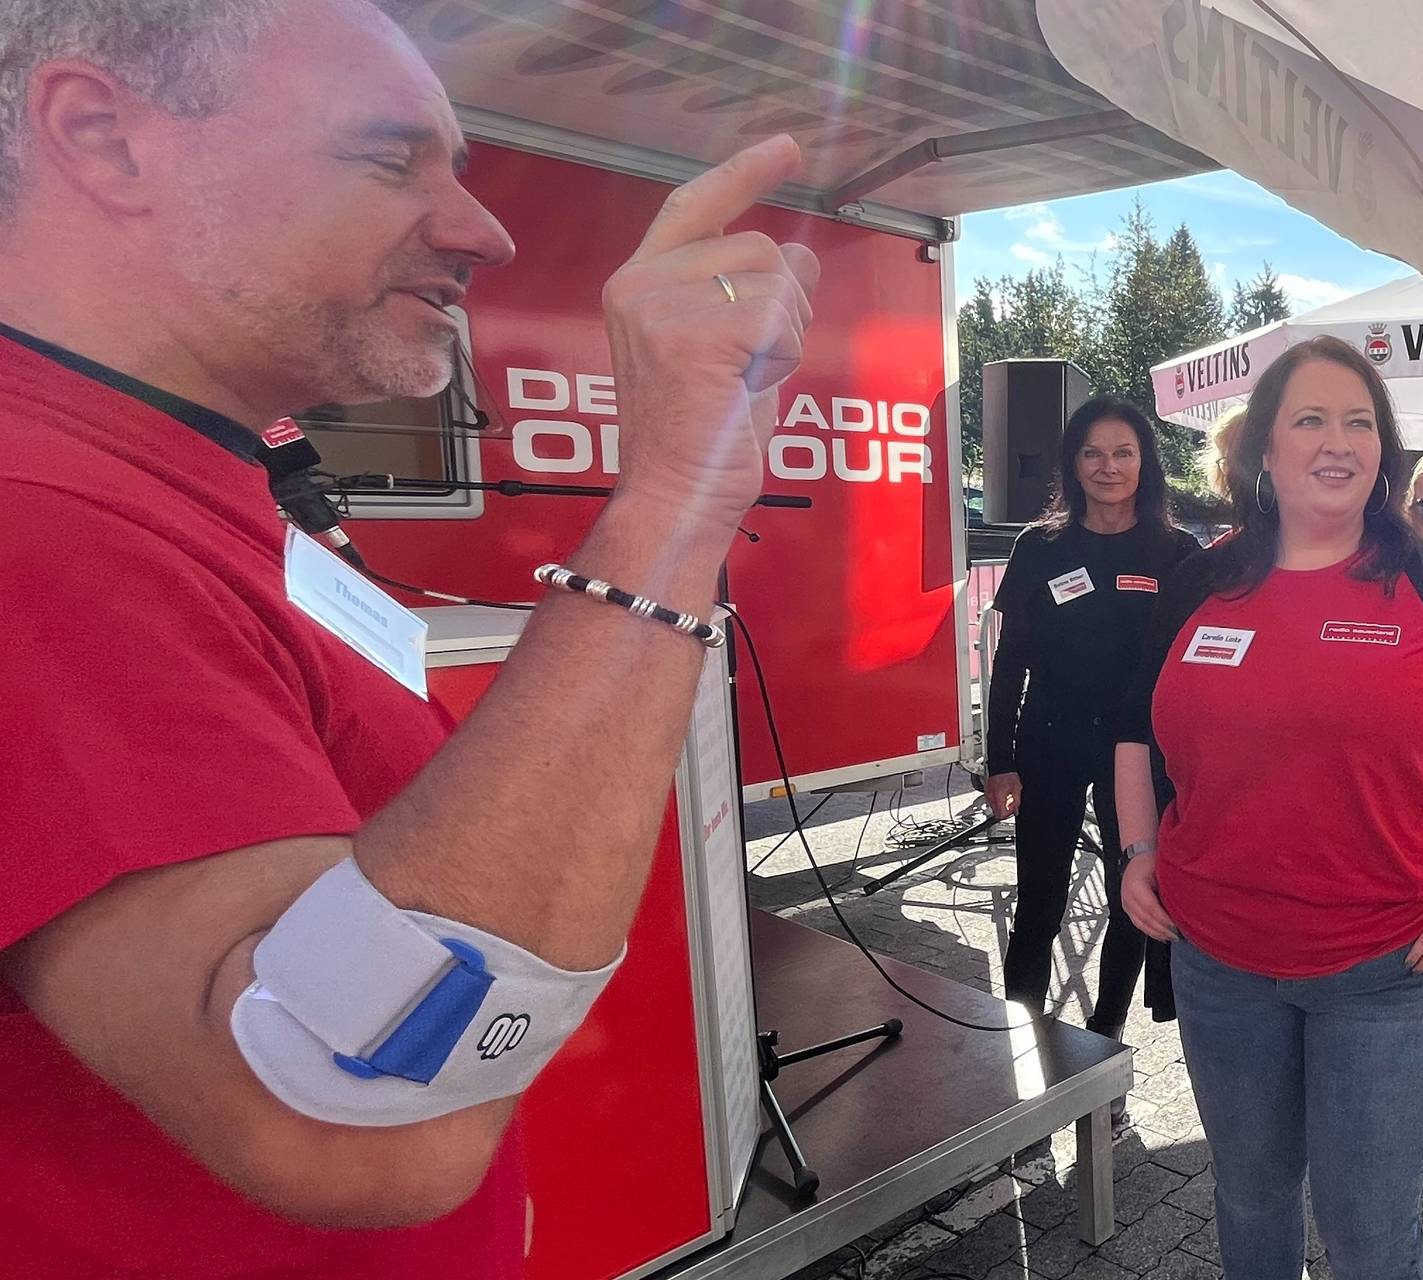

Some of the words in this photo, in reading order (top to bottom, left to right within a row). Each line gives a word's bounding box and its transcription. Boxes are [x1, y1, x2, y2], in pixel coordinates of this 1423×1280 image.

[1187, 342, 1250, 393] VELTINS
[775, 393, 932, 437] ADIO
[768, 434, 933, 484] OUR
